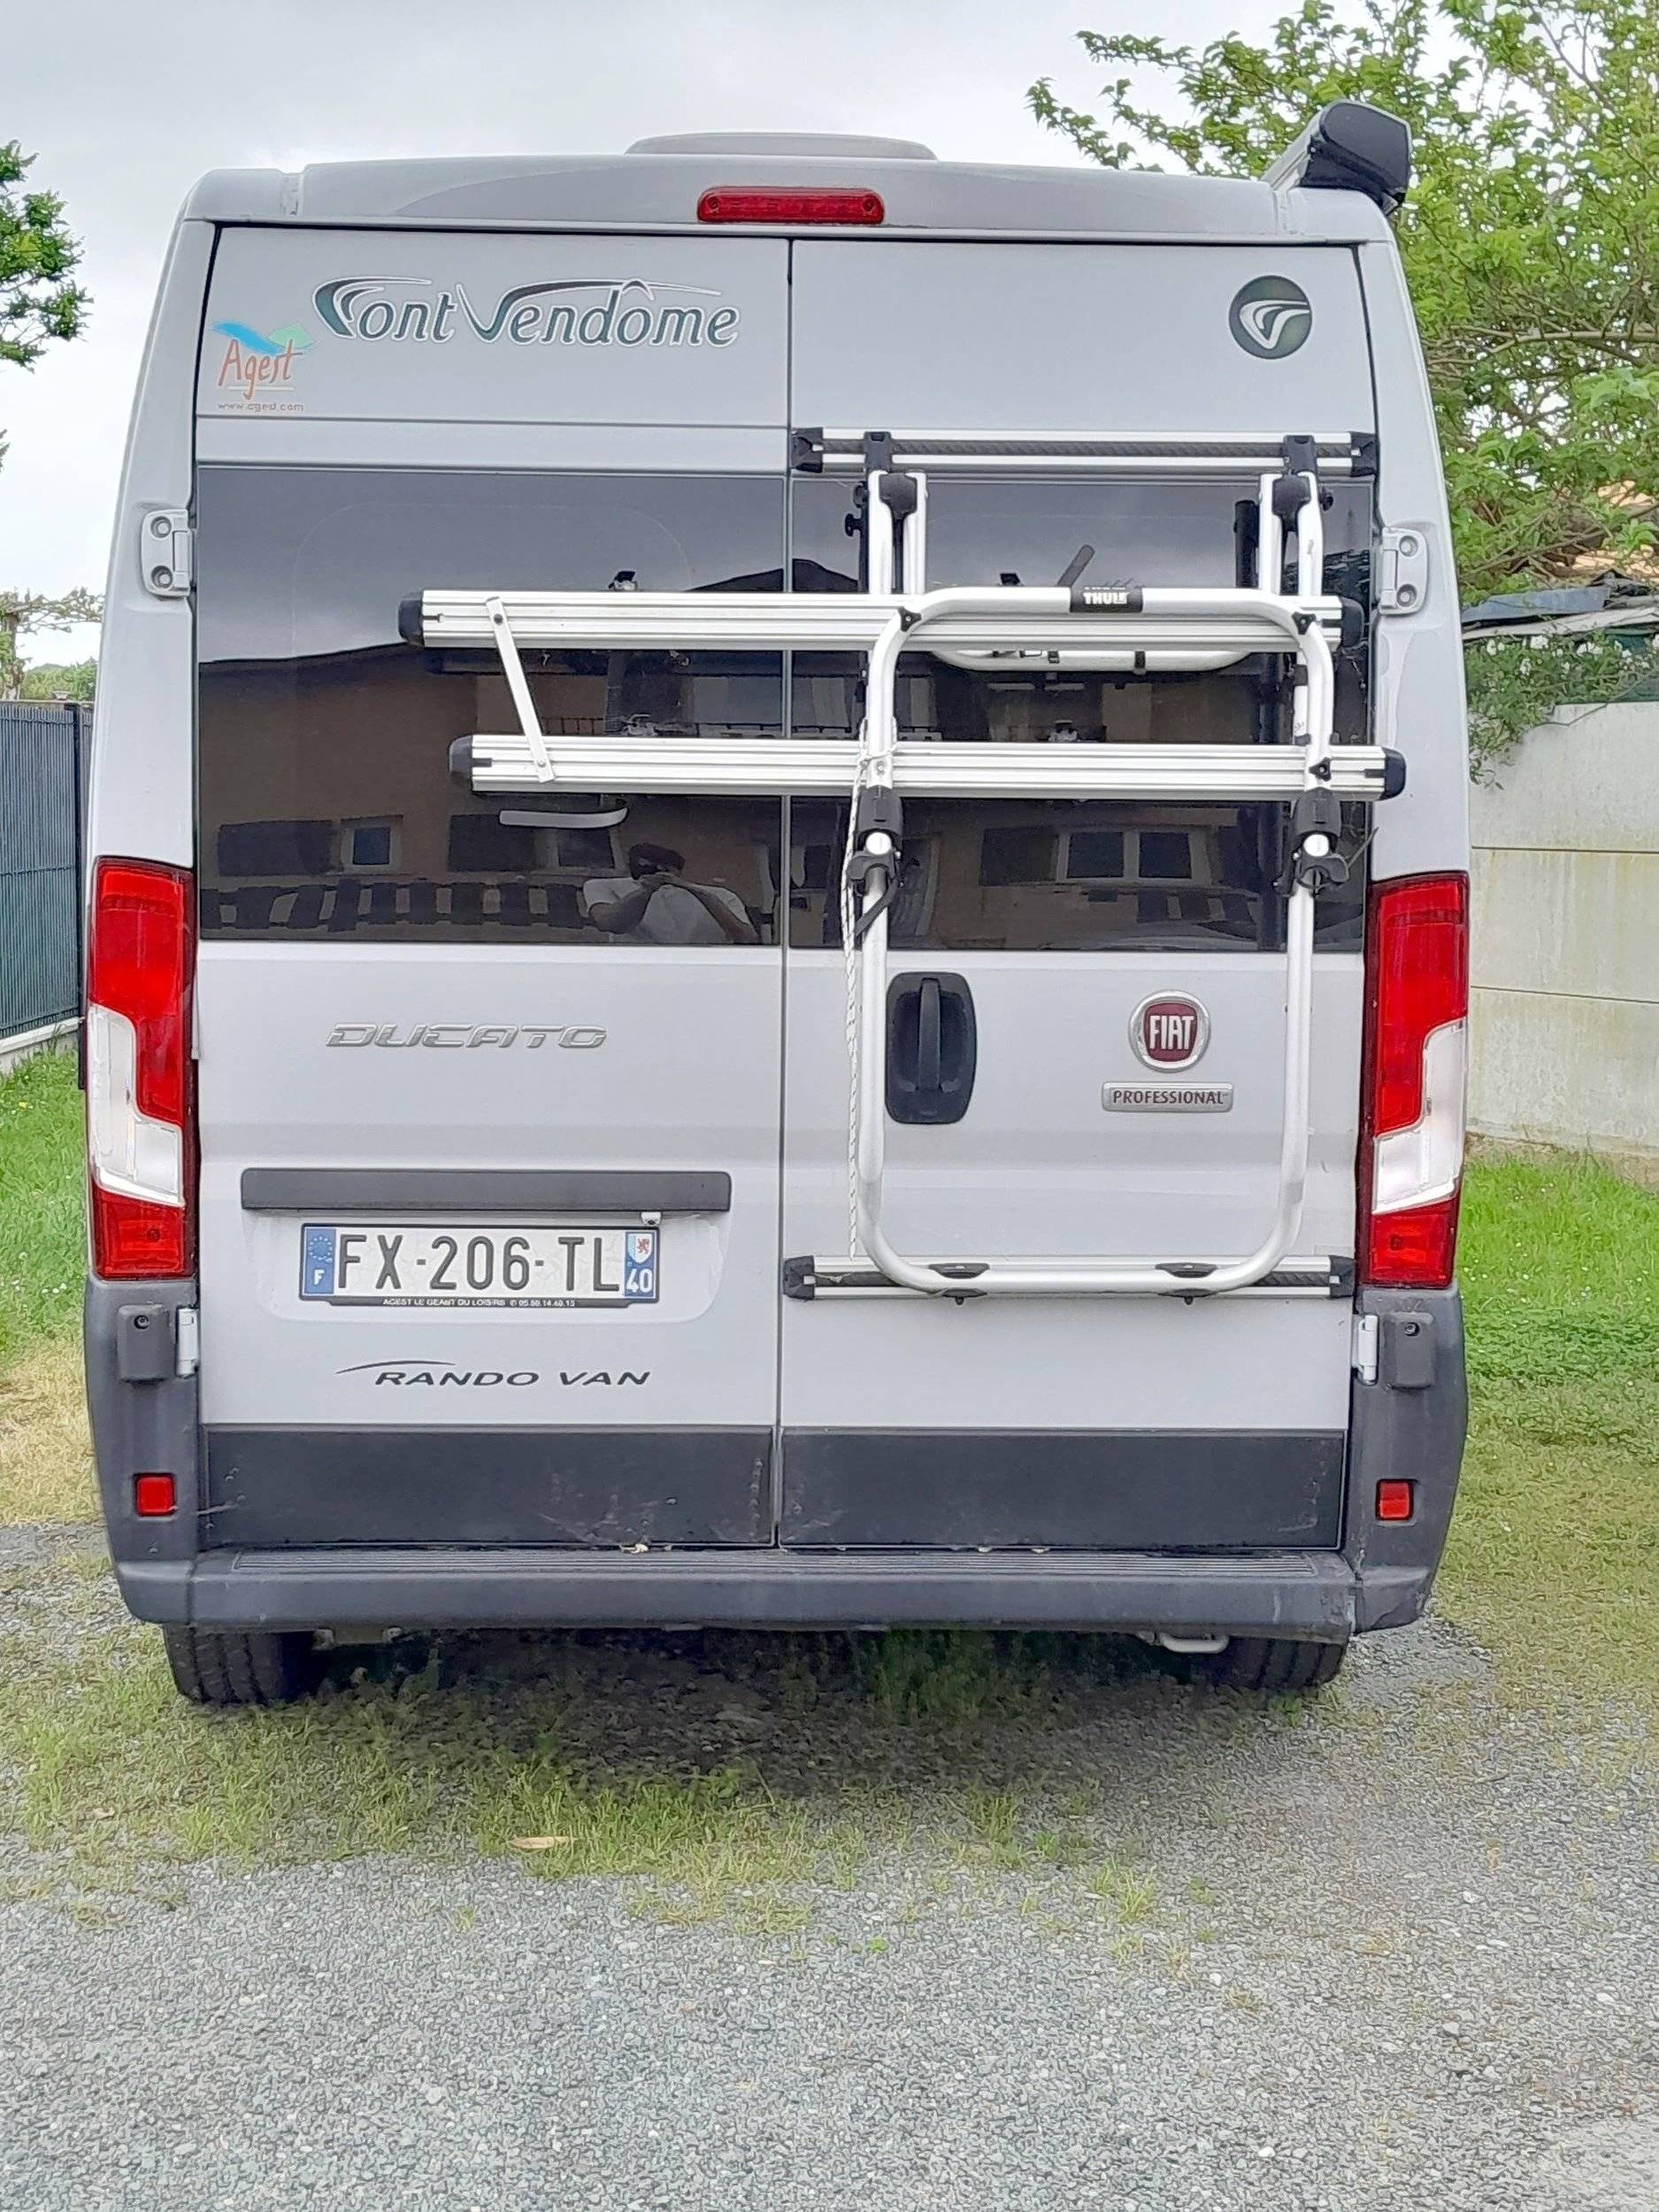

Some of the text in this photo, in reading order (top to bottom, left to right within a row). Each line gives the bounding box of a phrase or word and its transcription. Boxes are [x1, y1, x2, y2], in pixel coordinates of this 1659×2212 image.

[457, 279, 739, 347] Vendôme
[218, 338, 303, 400] Agest
[1082, 592, 1130, 605] THULE
[326, 1023, 608, 1049] DUCATO
[1149, 1015, 1195, 1050] FIAT
[1112, 1090, 1225, 1105] PROFESSIONAL
[338, 1233, 620, 1292] FX-206-TL
[313, 1269, 325, 1286] F
[626, 1268, 653, 1294] 40
[374, 1371, 651, 1386] RANDO VAN
